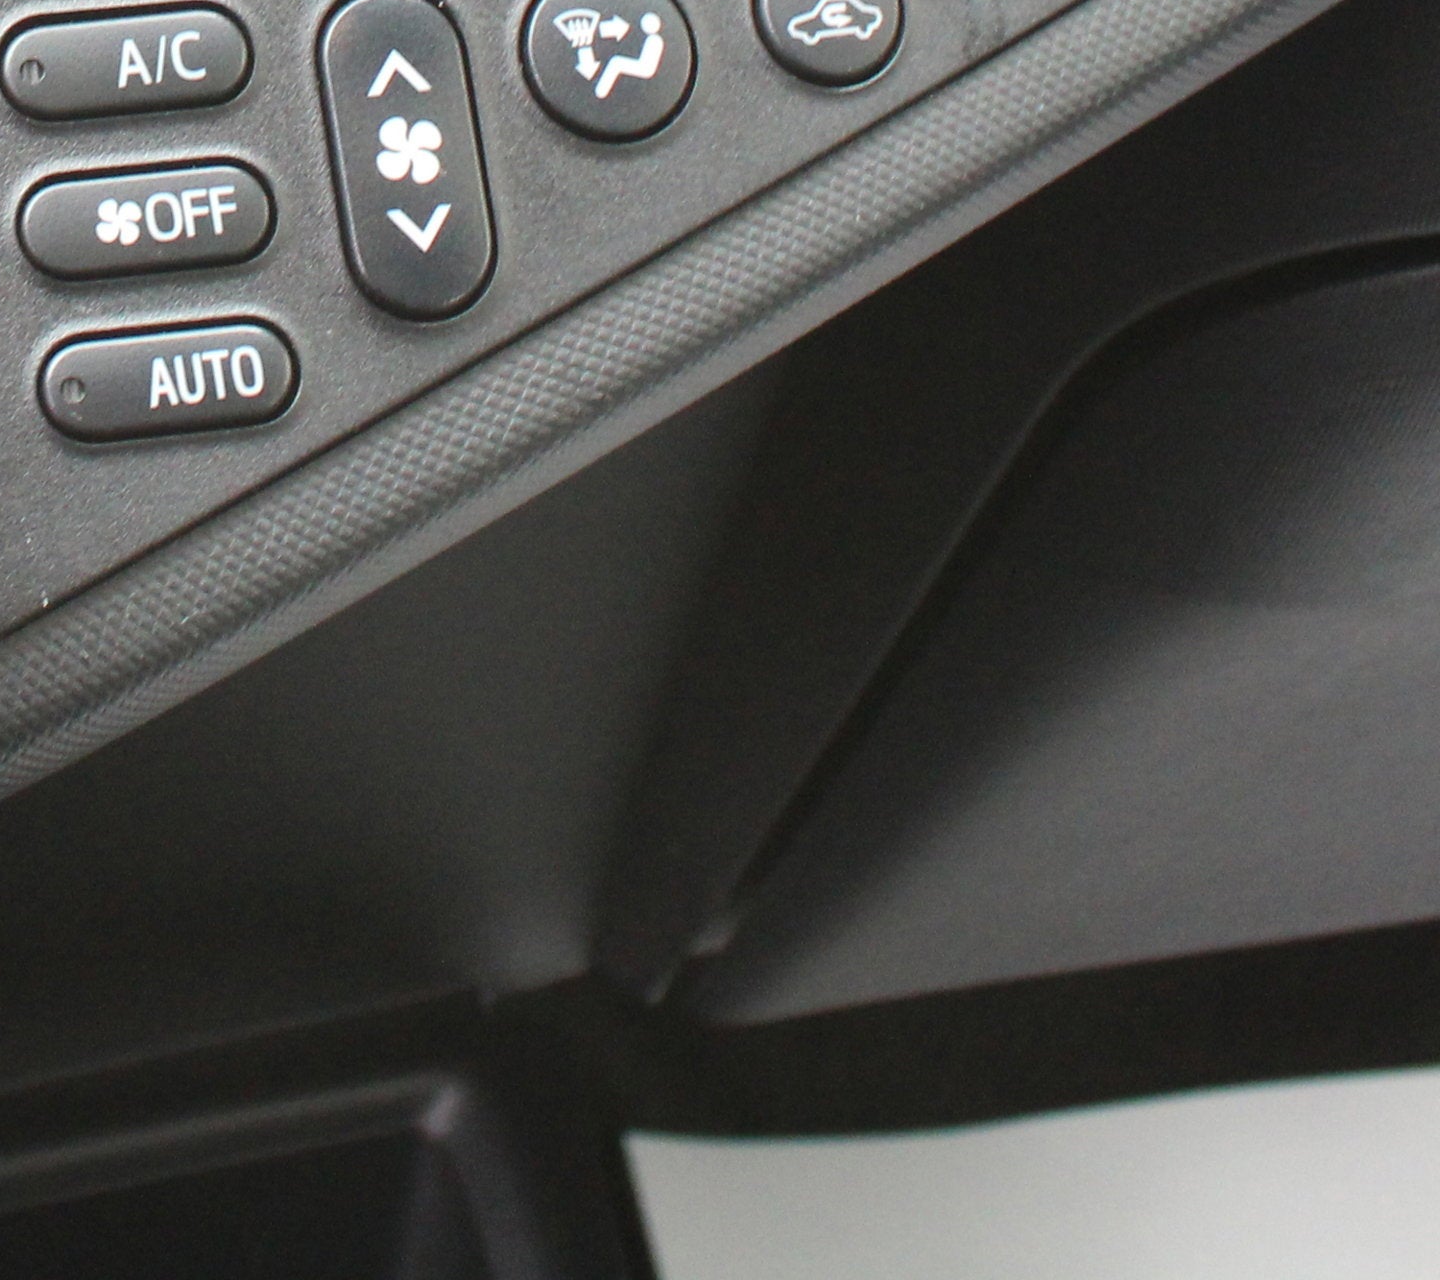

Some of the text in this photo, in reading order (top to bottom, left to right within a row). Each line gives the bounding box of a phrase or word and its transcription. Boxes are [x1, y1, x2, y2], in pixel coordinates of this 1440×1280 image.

[116, 29, 207, 89] A/C
[144, 185, 238, 243] OFF
[148, 344, 265, 410] AUTO
